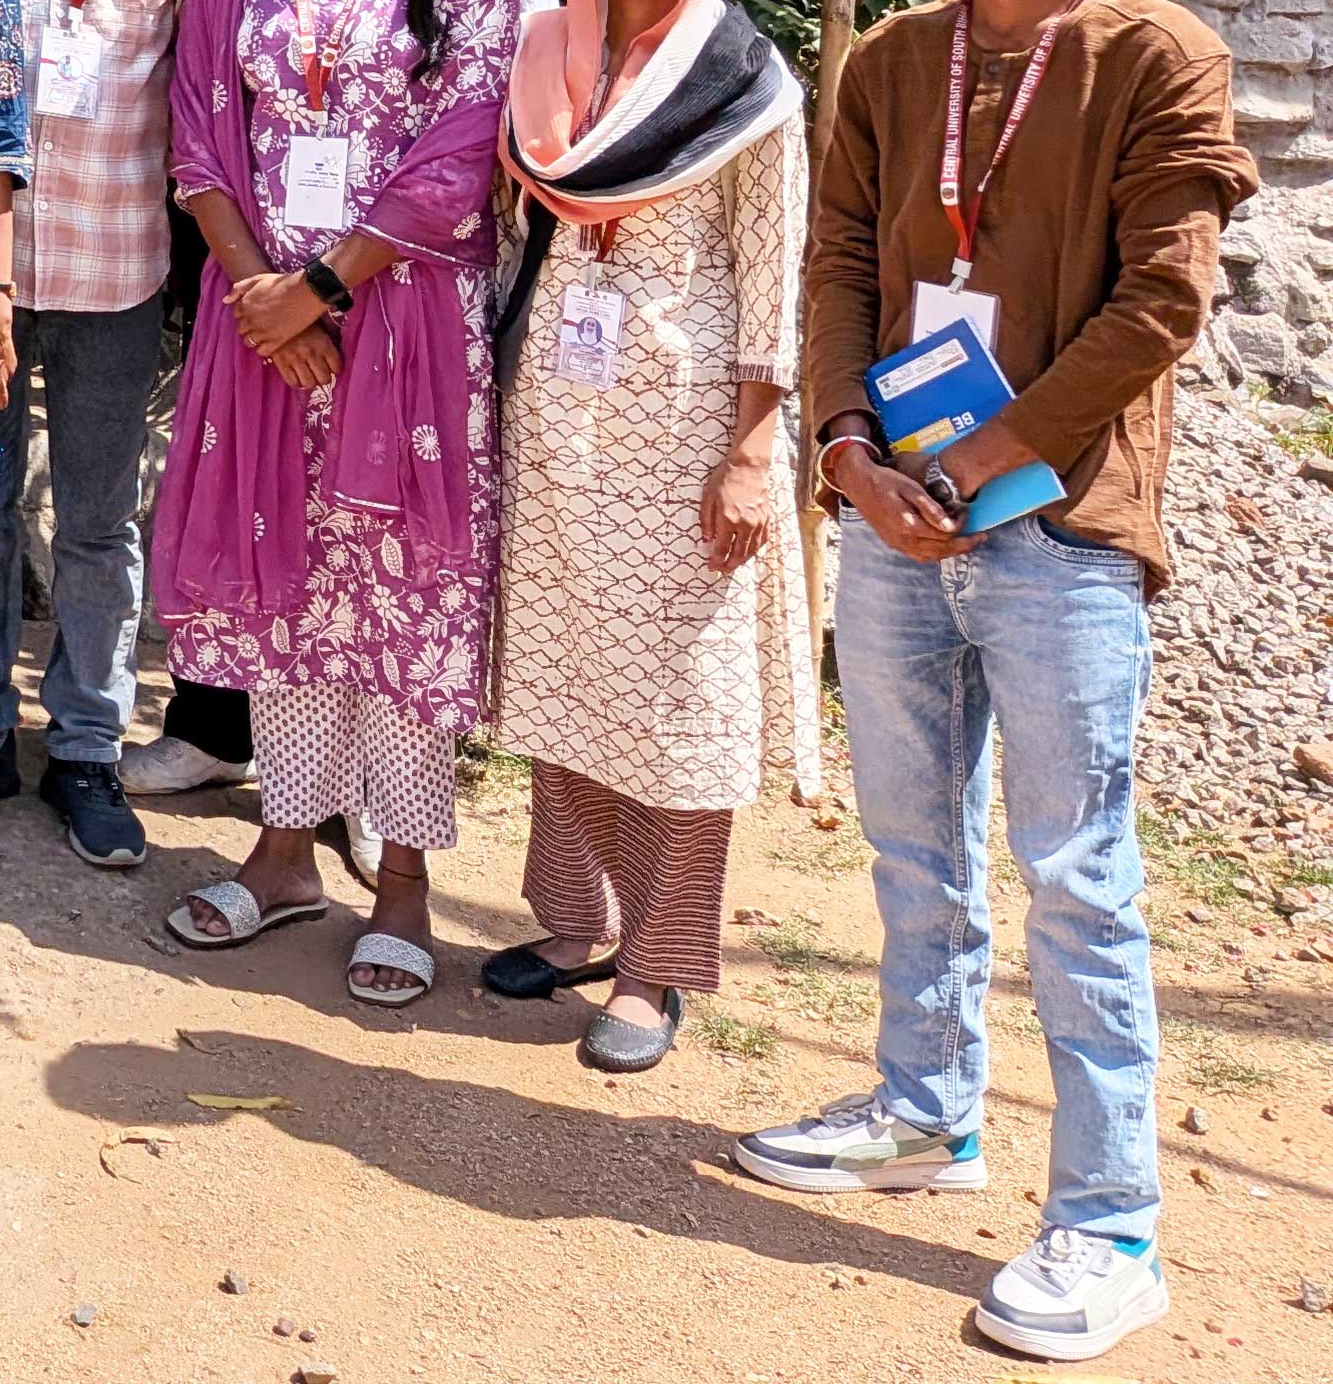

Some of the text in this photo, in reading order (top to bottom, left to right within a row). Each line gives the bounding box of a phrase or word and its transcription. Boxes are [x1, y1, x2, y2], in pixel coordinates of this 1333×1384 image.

[327, 8, 350, 45] CENTRAL
[951, 28, 966, 61] SOUTH
[950, 62, 963, 76] OF
[1007, 61, 1042, 123] UNIVERSITY
[1032, 47, 1048, 64] OF
[945, 75, 964, 135] UNIVERSITY
[942, 136, 959, 179] CENTRAL
